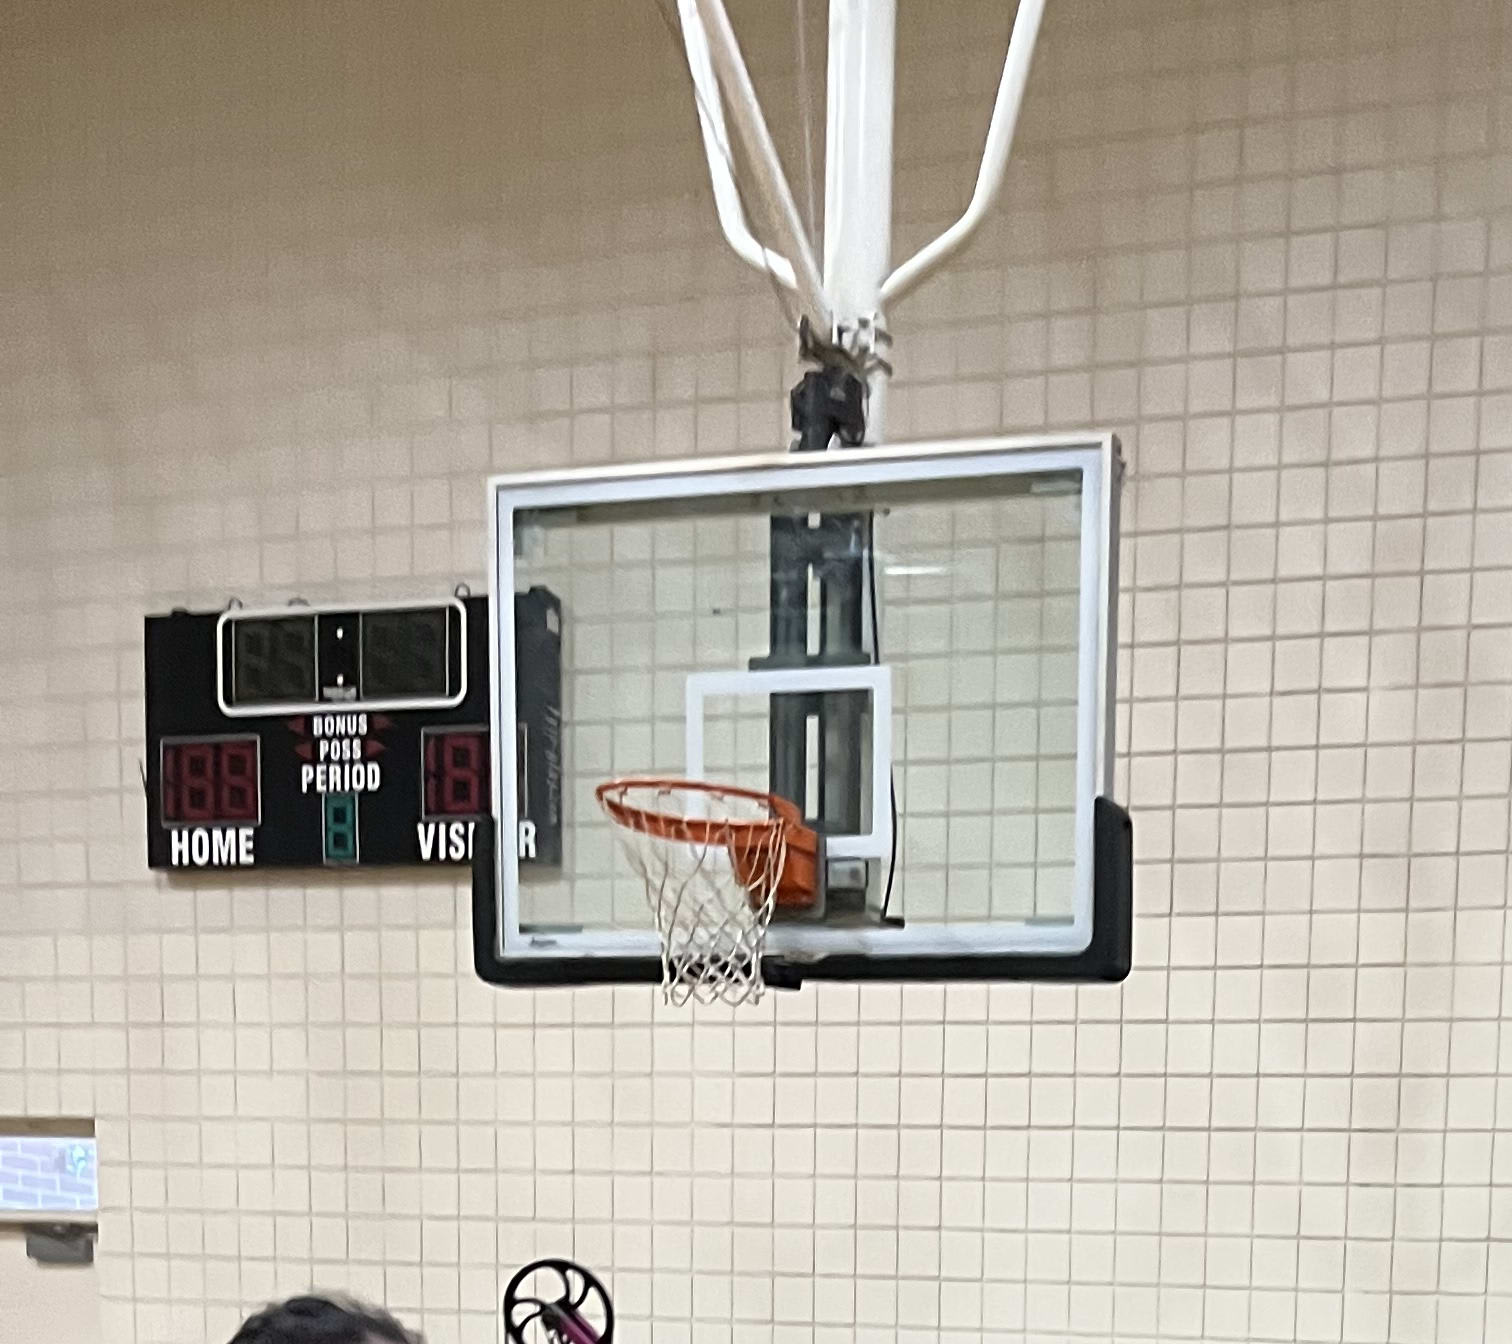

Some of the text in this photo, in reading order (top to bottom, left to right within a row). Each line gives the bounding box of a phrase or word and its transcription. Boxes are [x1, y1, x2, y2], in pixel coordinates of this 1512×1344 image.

[313, 713, 368, 737] BONUS
[319, 738, 361, 762] POSS
[301, 761, 380, 794] PERIOD
[171, 827, 255, 866] HOME
[417, 821, 536, 861] VISIR
